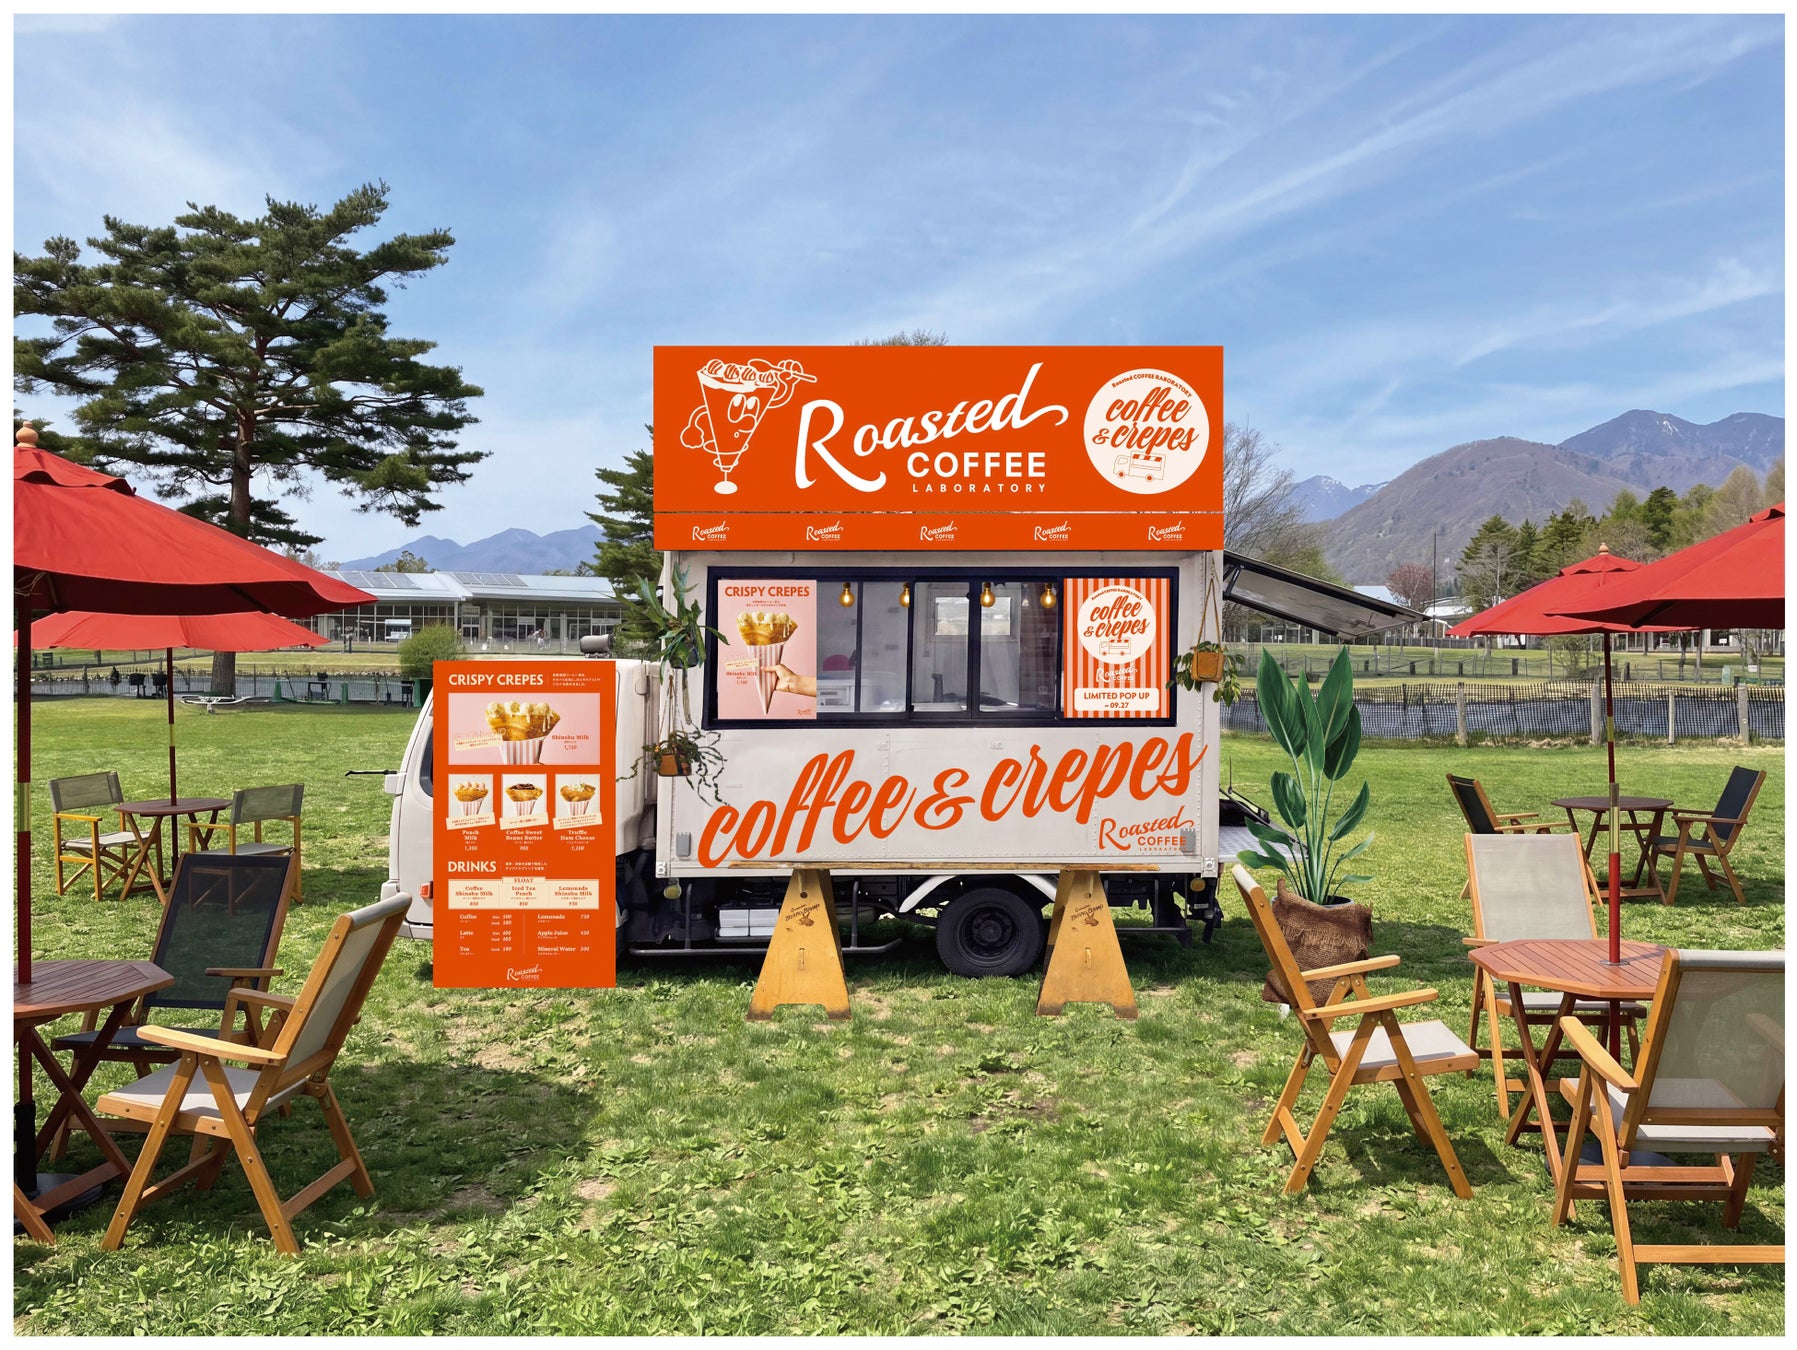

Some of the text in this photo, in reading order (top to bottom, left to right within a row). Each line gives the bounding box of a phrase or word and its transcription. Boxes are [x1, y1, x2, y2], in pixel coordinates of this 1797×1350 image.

[1111, 375, 1133, 388] Roasted
[1155, 374, 1192, 398] RABORATORY
[1105, 386, 1192, 423] coffee
[794, 362, 1069, 492] Roasted
[1091, 422, 1200, 455] & crepes
[907, 453, 1045, 478] COFFEE
[913, 484, 1045, 493] LABORATORY
[724, 586, 810, 597] CRISPY CREPES
[1089, 595, 1143, 622] coffee
[1083, 618, 1150, 640] & crepes
[448, 674, 494, 686] CRISPY
[497, 674, 544, 686] CREPES
[1083, 692, 1150, 700] LIMITED POP UP
[698, 732, 1209, 868] coffee & crepes
[1098, 805, 1195, 851] Roasted
[1137, 836, 1187, 846] COFFEE
[448, 861, 497, 872] DRINKS
